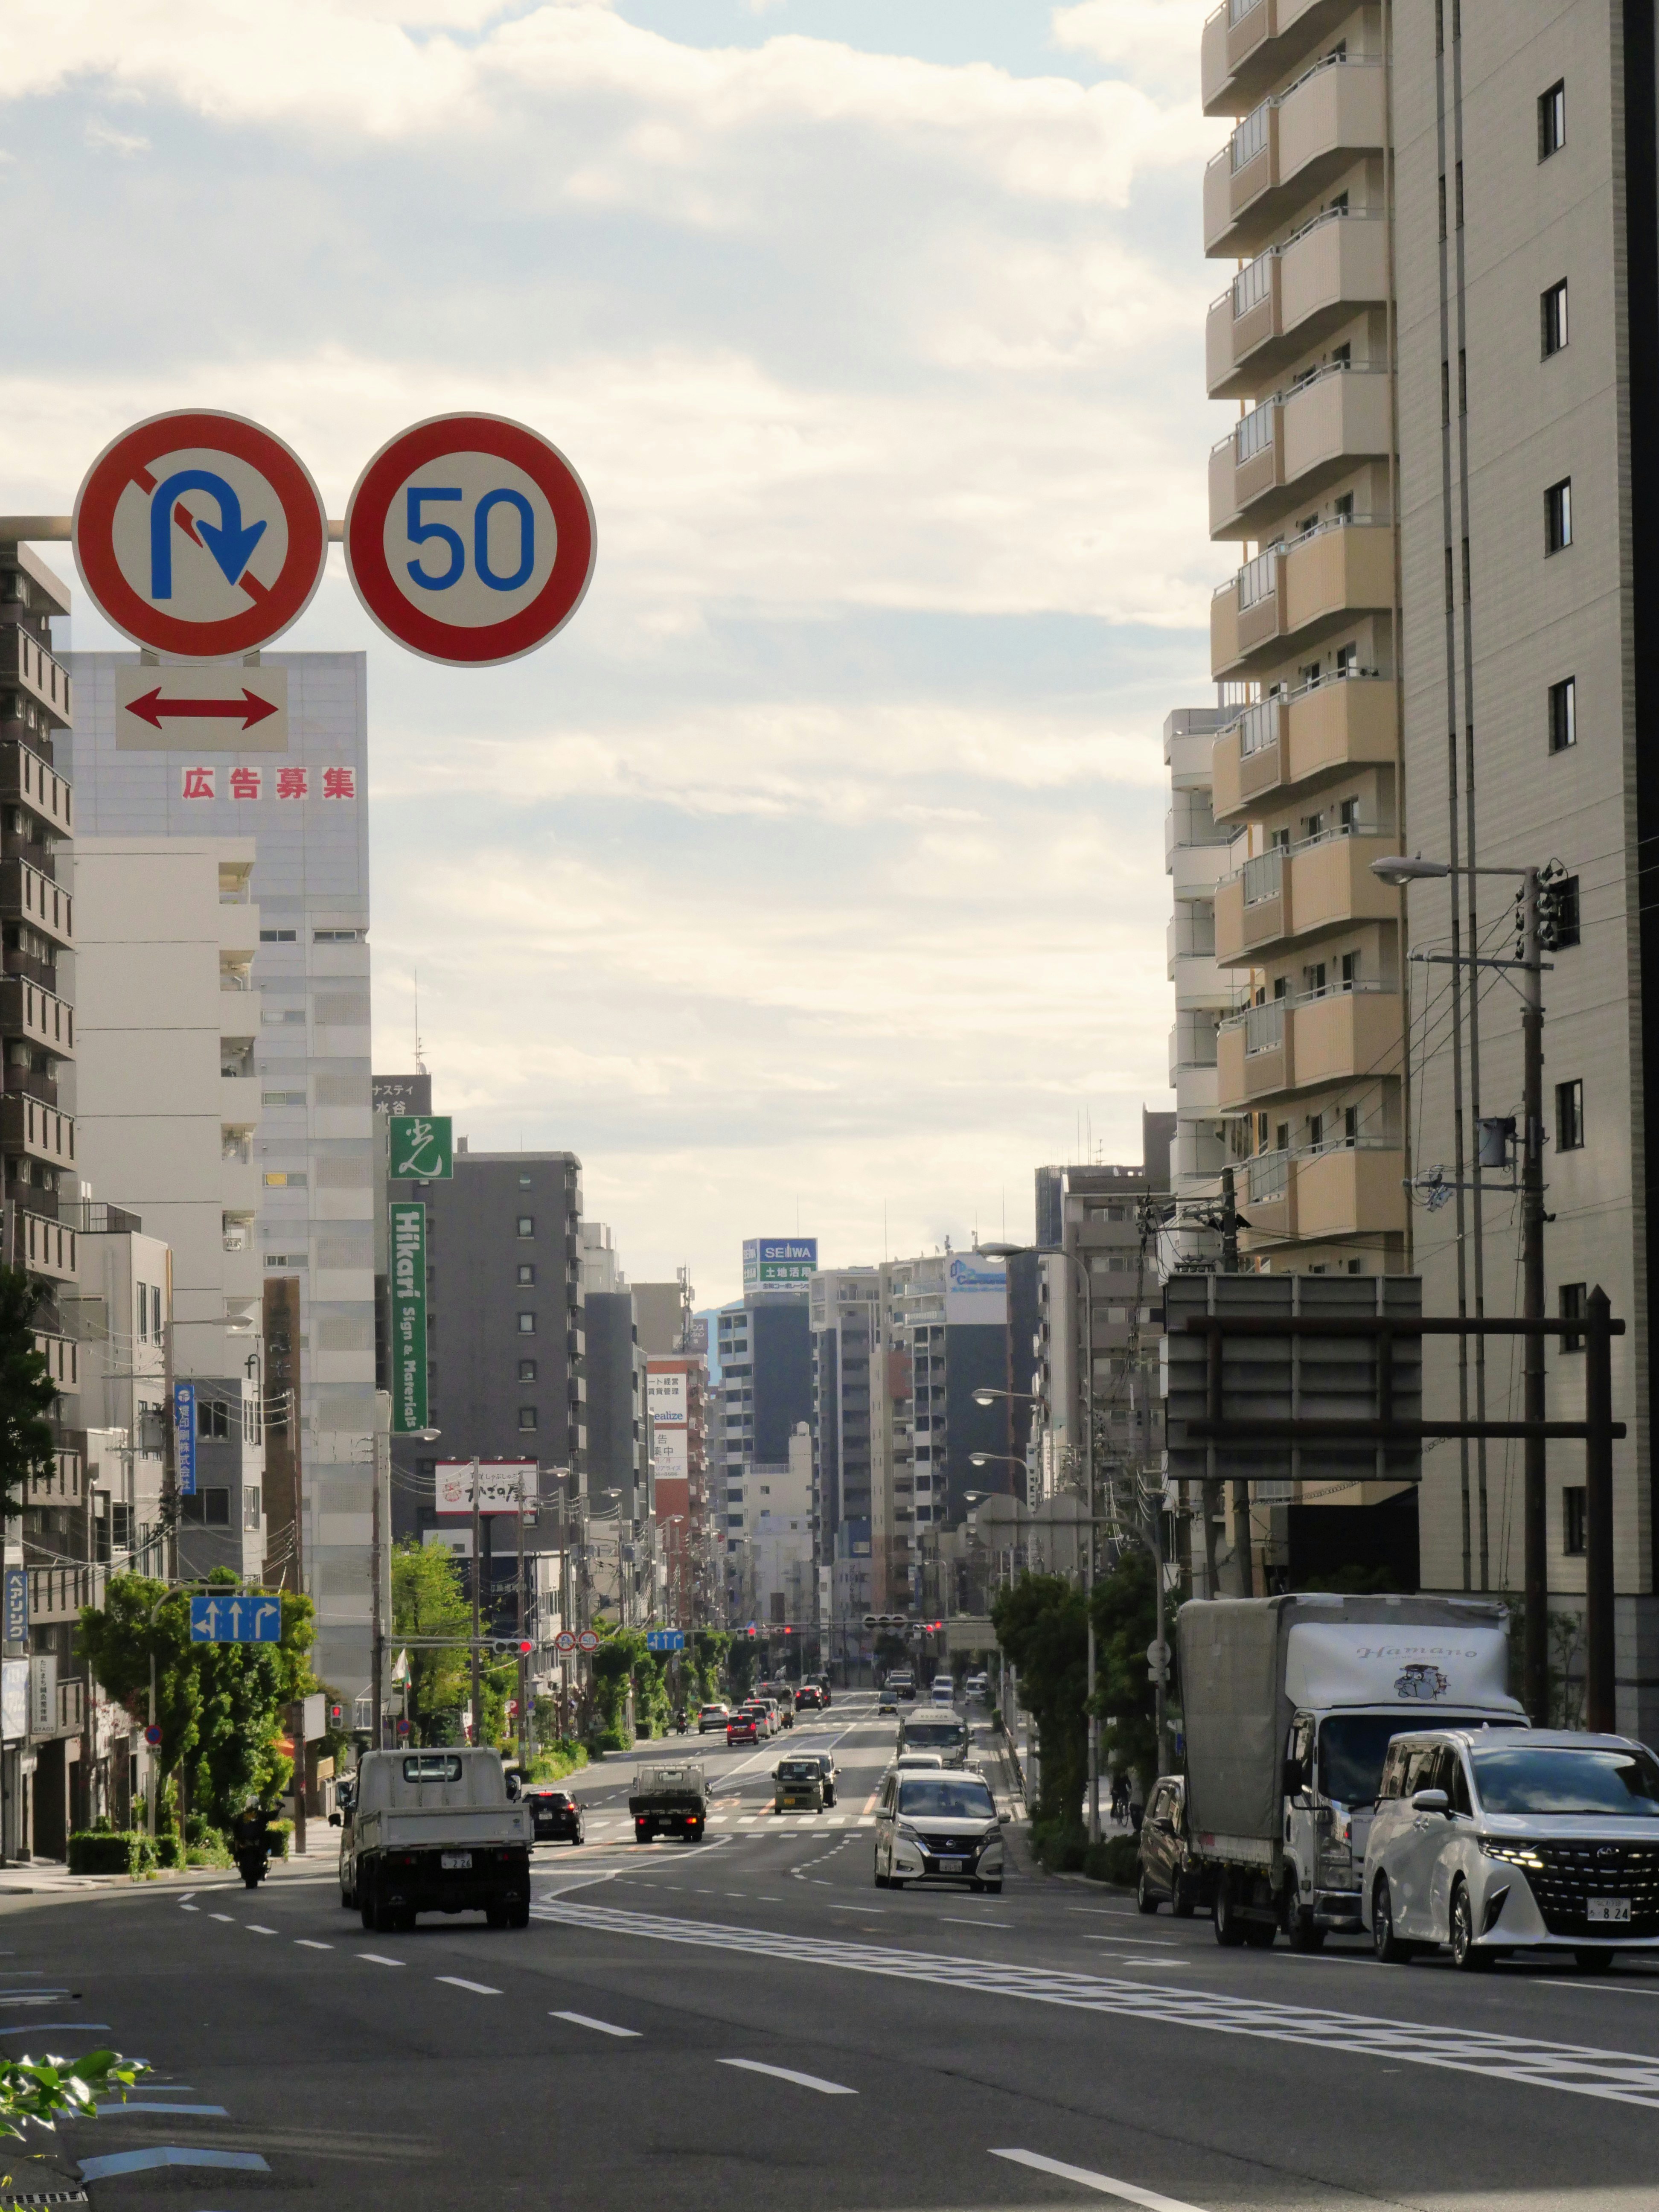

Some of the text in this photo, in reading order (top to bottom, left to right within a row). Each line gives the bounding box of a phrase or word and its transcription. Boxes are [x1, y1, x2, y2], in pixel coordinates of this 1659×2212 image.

[407, 488, 534, 591] 50
[183, 768, 355, 800] 広告募集
[376, 1100, 406, 1115] 水谷
[766, 1267, 811, 1278] 土地活用
[396, 1211, 420, 1427] Hikari Sign & Materials
[654, 1434, 667, 1444] 告
[1357, 1645, 1477, 1659] Hamano
